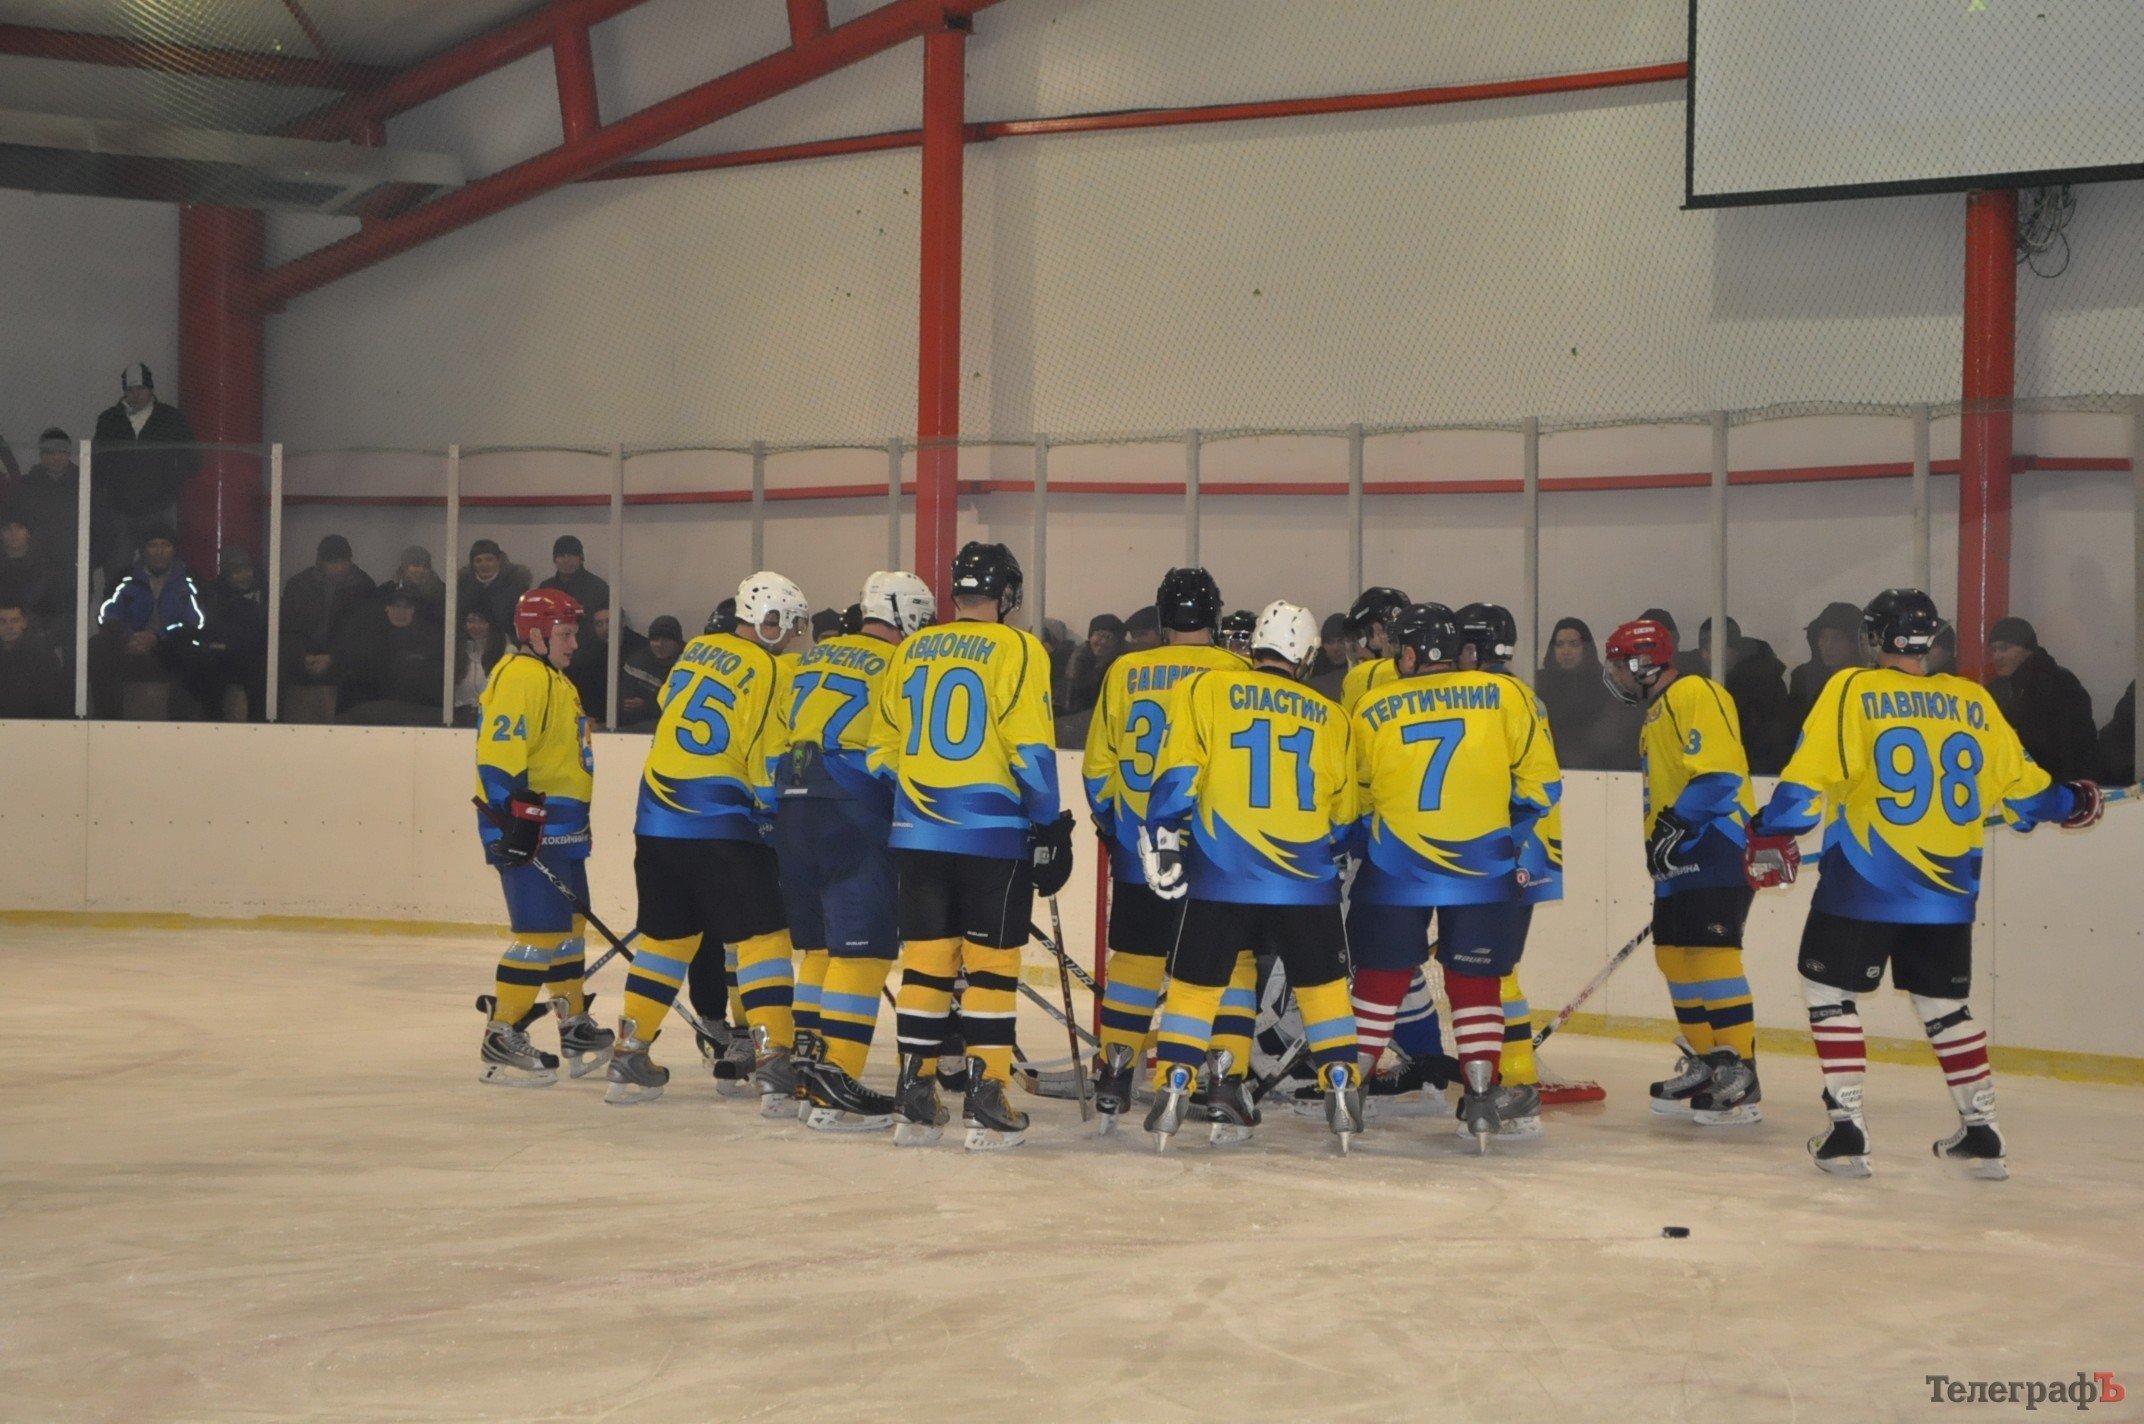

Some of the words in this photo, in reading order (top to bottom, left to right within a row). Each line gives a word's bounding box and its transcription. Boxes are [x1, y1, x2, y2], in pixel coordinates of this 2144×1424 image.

[492, 713, 527, 741] 24
[662, 668, 736, 756] 75
[901, 665, 988, 762] 10
[1229, 683, 1329, 726] СЛАСТИН
[1361, 682, 1501, 732] ТЕРТИЧНИЙ
[1860, 690, 1961, 722] ПАВЛЮК
[1965, 700, 1990, 732] Ю.
[1229, 717, 1317, 812] 11
[1400, 717, 1466, 812] 7
[1873, 726, 1985, 826] 98
